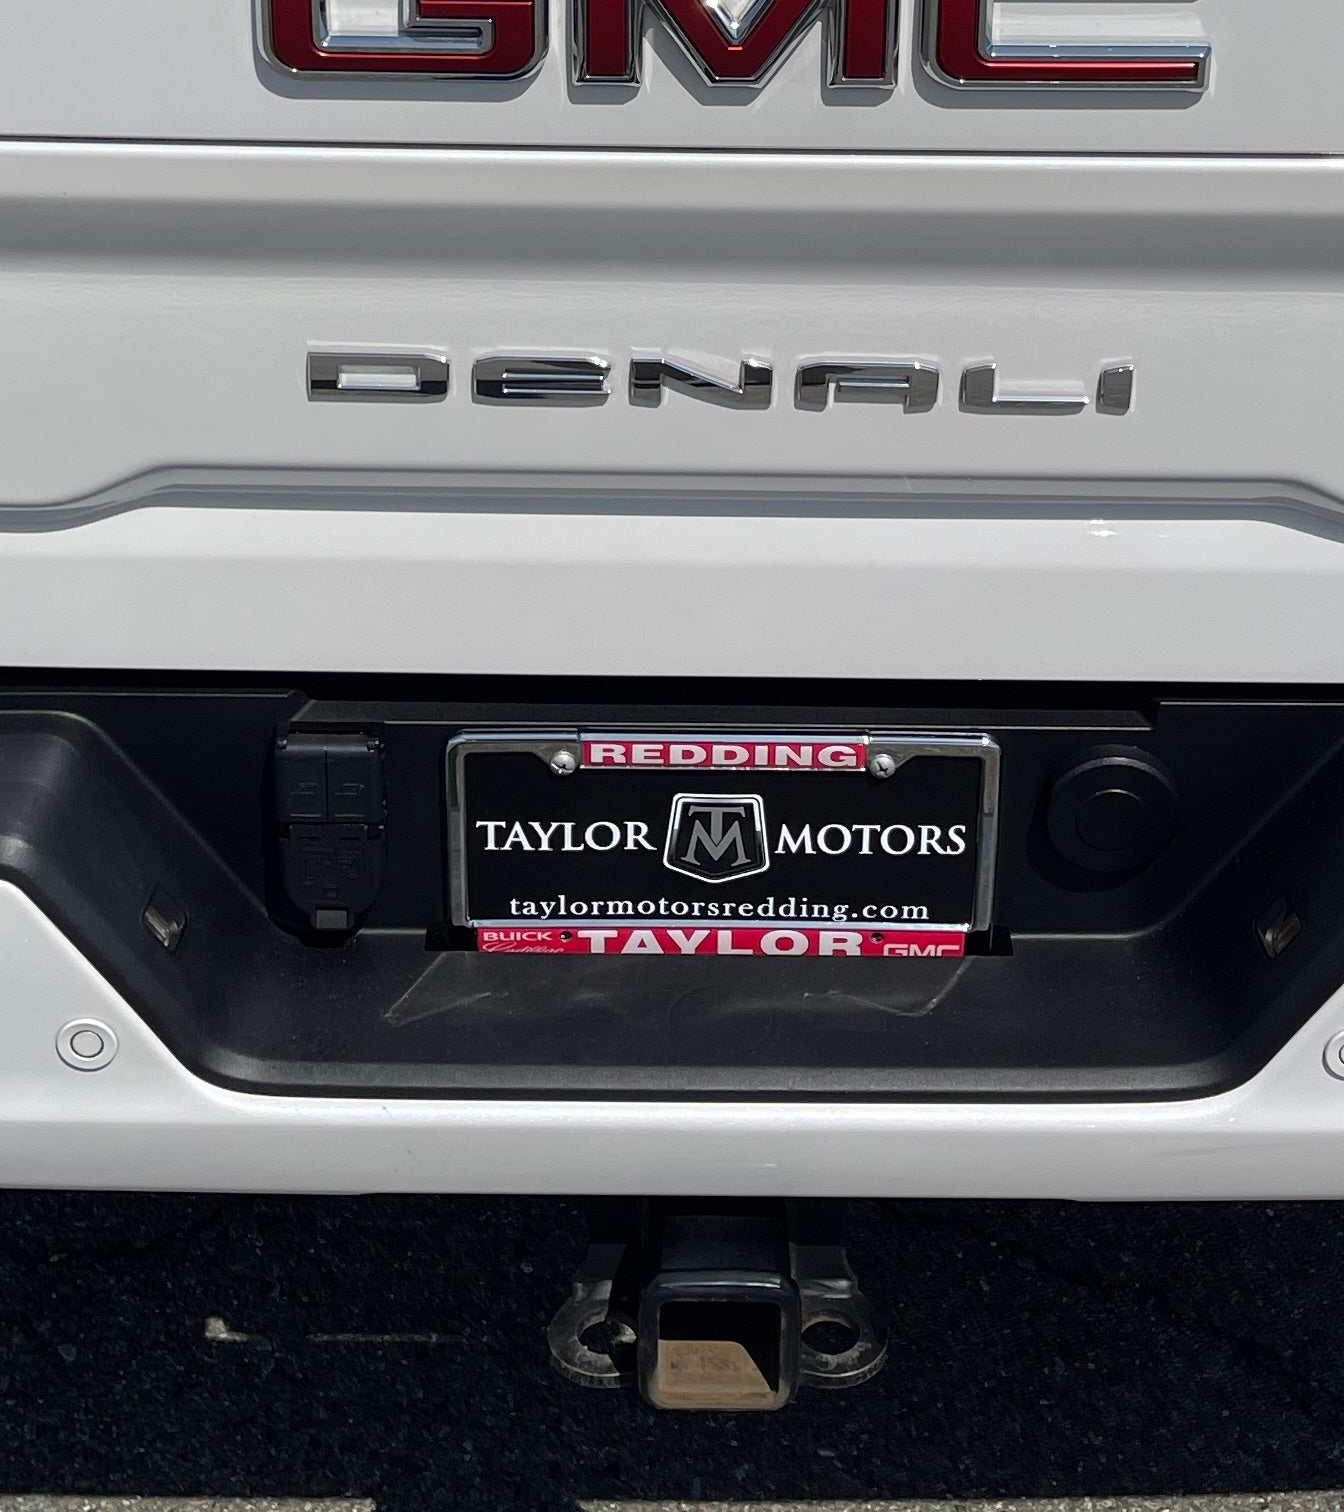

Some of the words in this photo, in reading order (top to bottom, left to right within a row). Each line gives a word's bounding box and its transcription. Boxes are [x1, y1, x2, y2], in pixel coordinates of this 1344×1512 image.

[306, 351, 1134, 415] DENALI
[590, 743, 857, 767] REDDING
[475, 820, 658, 852] TAYLOR
[774, 824, 967, 856] MOTORS
[510, 896, 929, 922] taylormotorsredding.com
[483, 931, 553, 941] BUICK
[578, 929, 864, 956] TAYLOR
[883, 943, 960, 956] GMC
